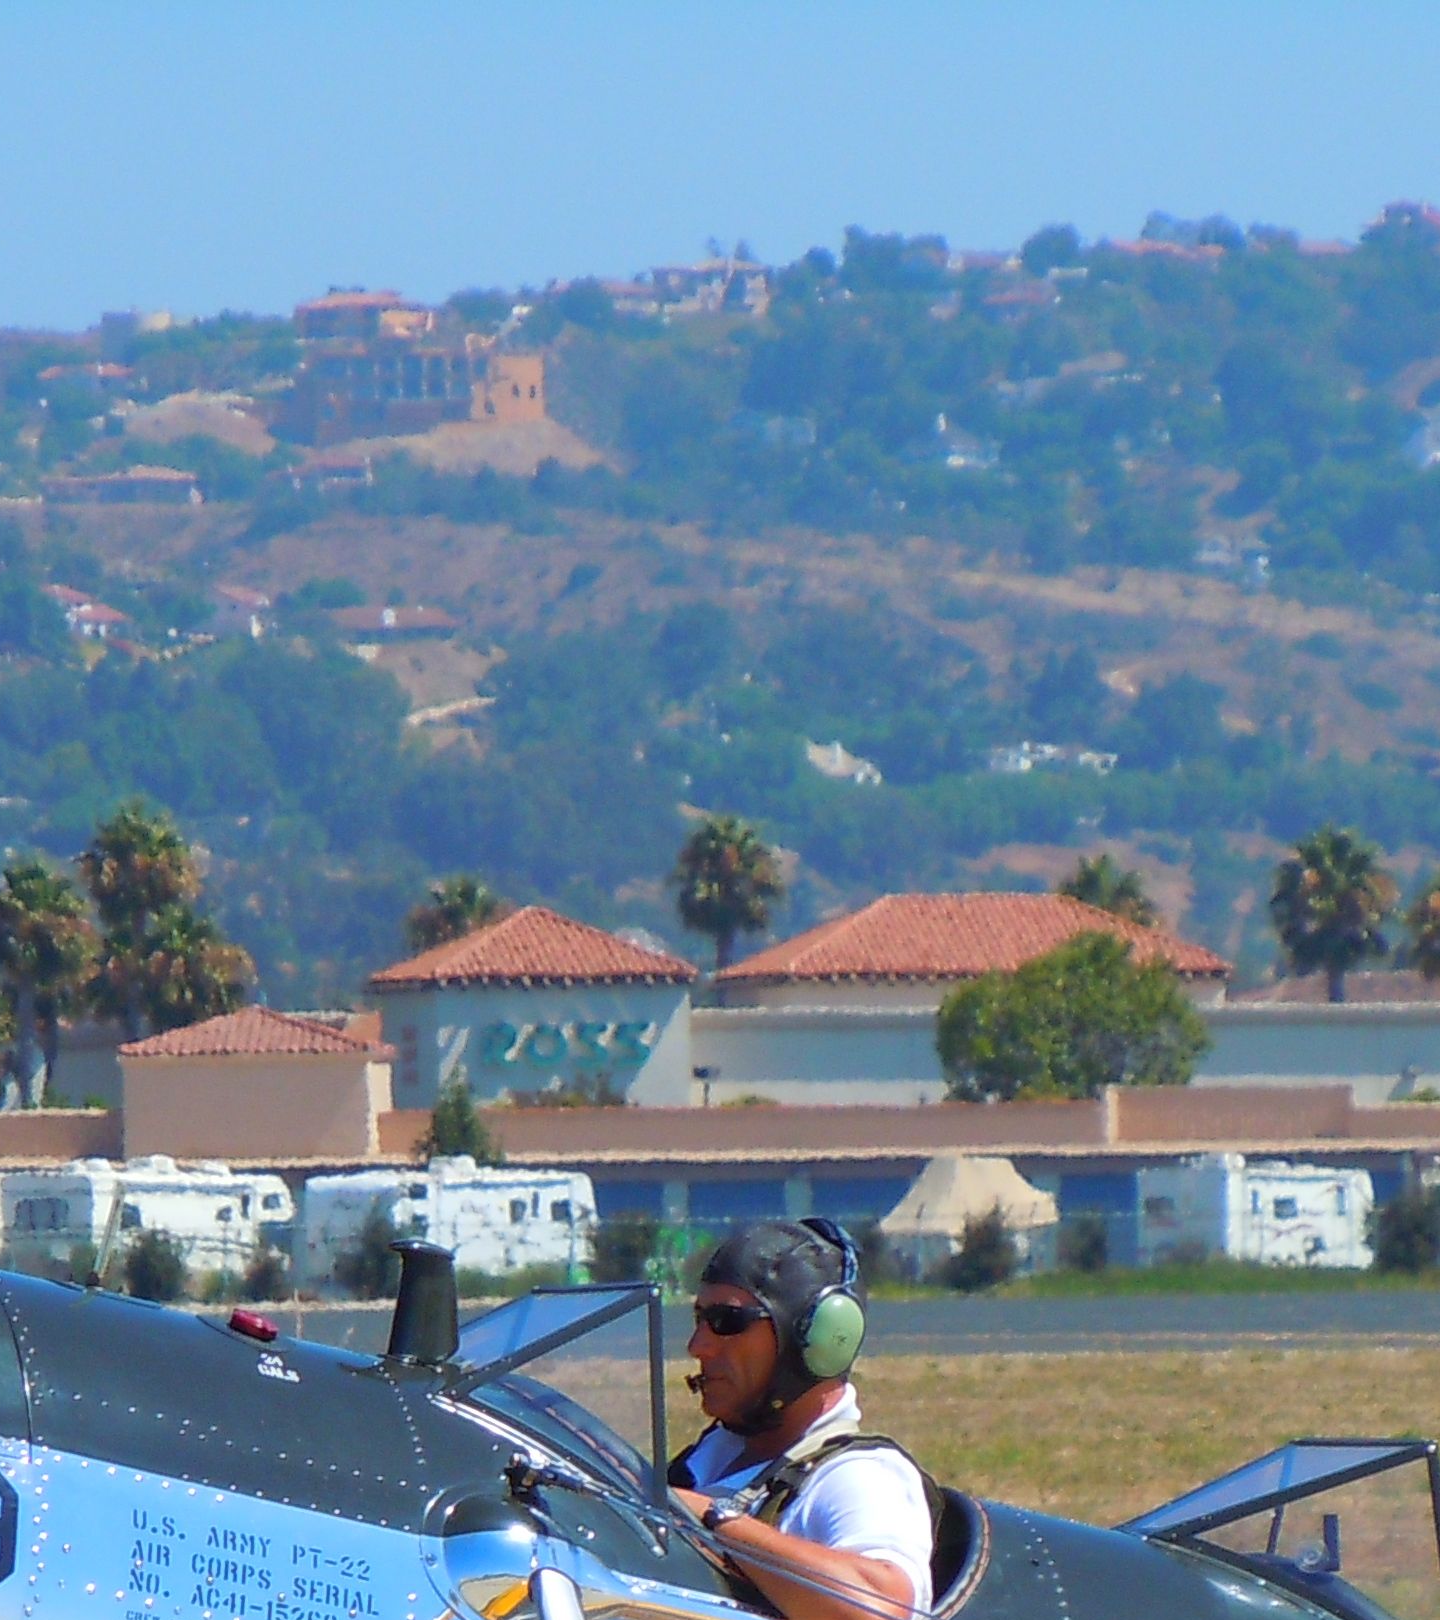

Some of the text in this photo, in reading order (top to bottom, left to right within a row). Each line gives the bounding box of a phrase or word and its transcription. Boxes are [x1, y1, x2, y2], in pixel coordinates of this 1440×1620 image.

[481, 1021, 657, 1067] ROSS
[132, 1509, 371, 1582] U.S. ARMY PT-22
[129, 1568, 171, 1599] NO.
[131, 1539, 380, 1617] AIR CORPS SERIAL
